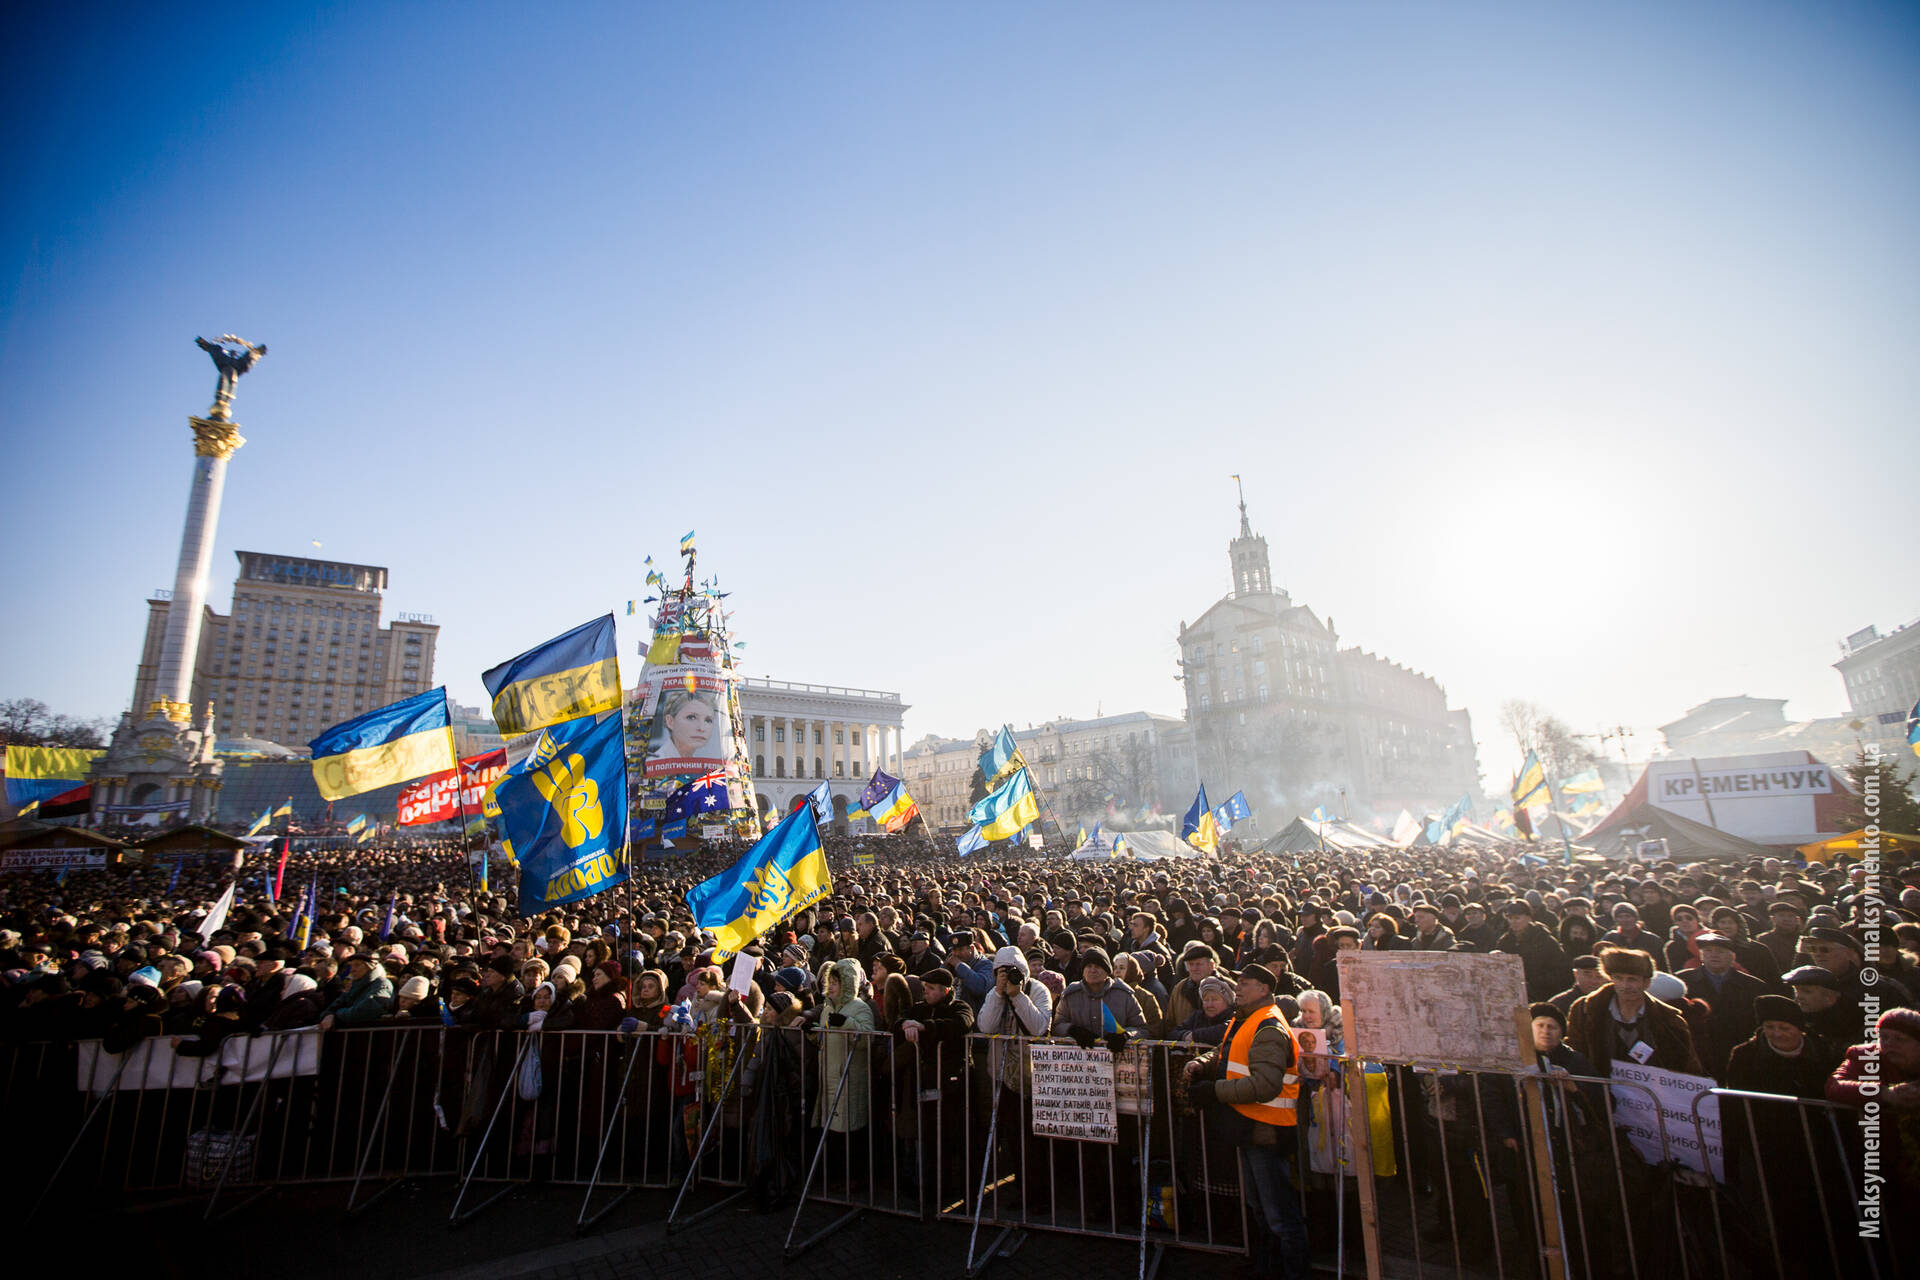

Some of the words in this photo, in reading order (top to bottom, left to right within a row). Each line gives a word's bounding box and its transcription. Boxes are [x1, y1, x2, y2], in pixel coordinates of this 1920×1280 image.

[656, 762, 702, 771] ПОЛІТИЧНИМ
[1665, 770, 1826, 796] КРЕМЕНЧУК
[4, 856, 87, 866] ЗАХАРЧЕНКА
[1032, 1050, 1048, 1061] НАМ
[1052, 1050, 1082, 1060] ВИПАЛО
[1033, 1063, 1051, 1072] ЧОМУ
[1054, 1064, 1058, 1072] В
[1061, 1064, 1083, 1073] СЕЛАХ
[1087, 1065, 1097, 1073] НА
[1085, 1075, 1090, 1083] В
[1092, 1076, 1112, 1086] ЧЕСТЬ
[1038, 1086, 1076, 1096] ЗАГИБЛИХ
[1078, 1088, 1088, 1096] НА
[1089, 1088, 1109, 1097] ВІЙНІ
[1035, 1099, 1060, 1108] НАШИХ
[1036, 1110, 1058, 1121] НЕМА
[1061, 1110, 1070, 1121] ЇХ
[1073, 1111, 1094, 1122] ІМЕНІ
[1098, 1113, 1110, 1124] ТА
[1035, 1123, 1045, 1132] ПО
